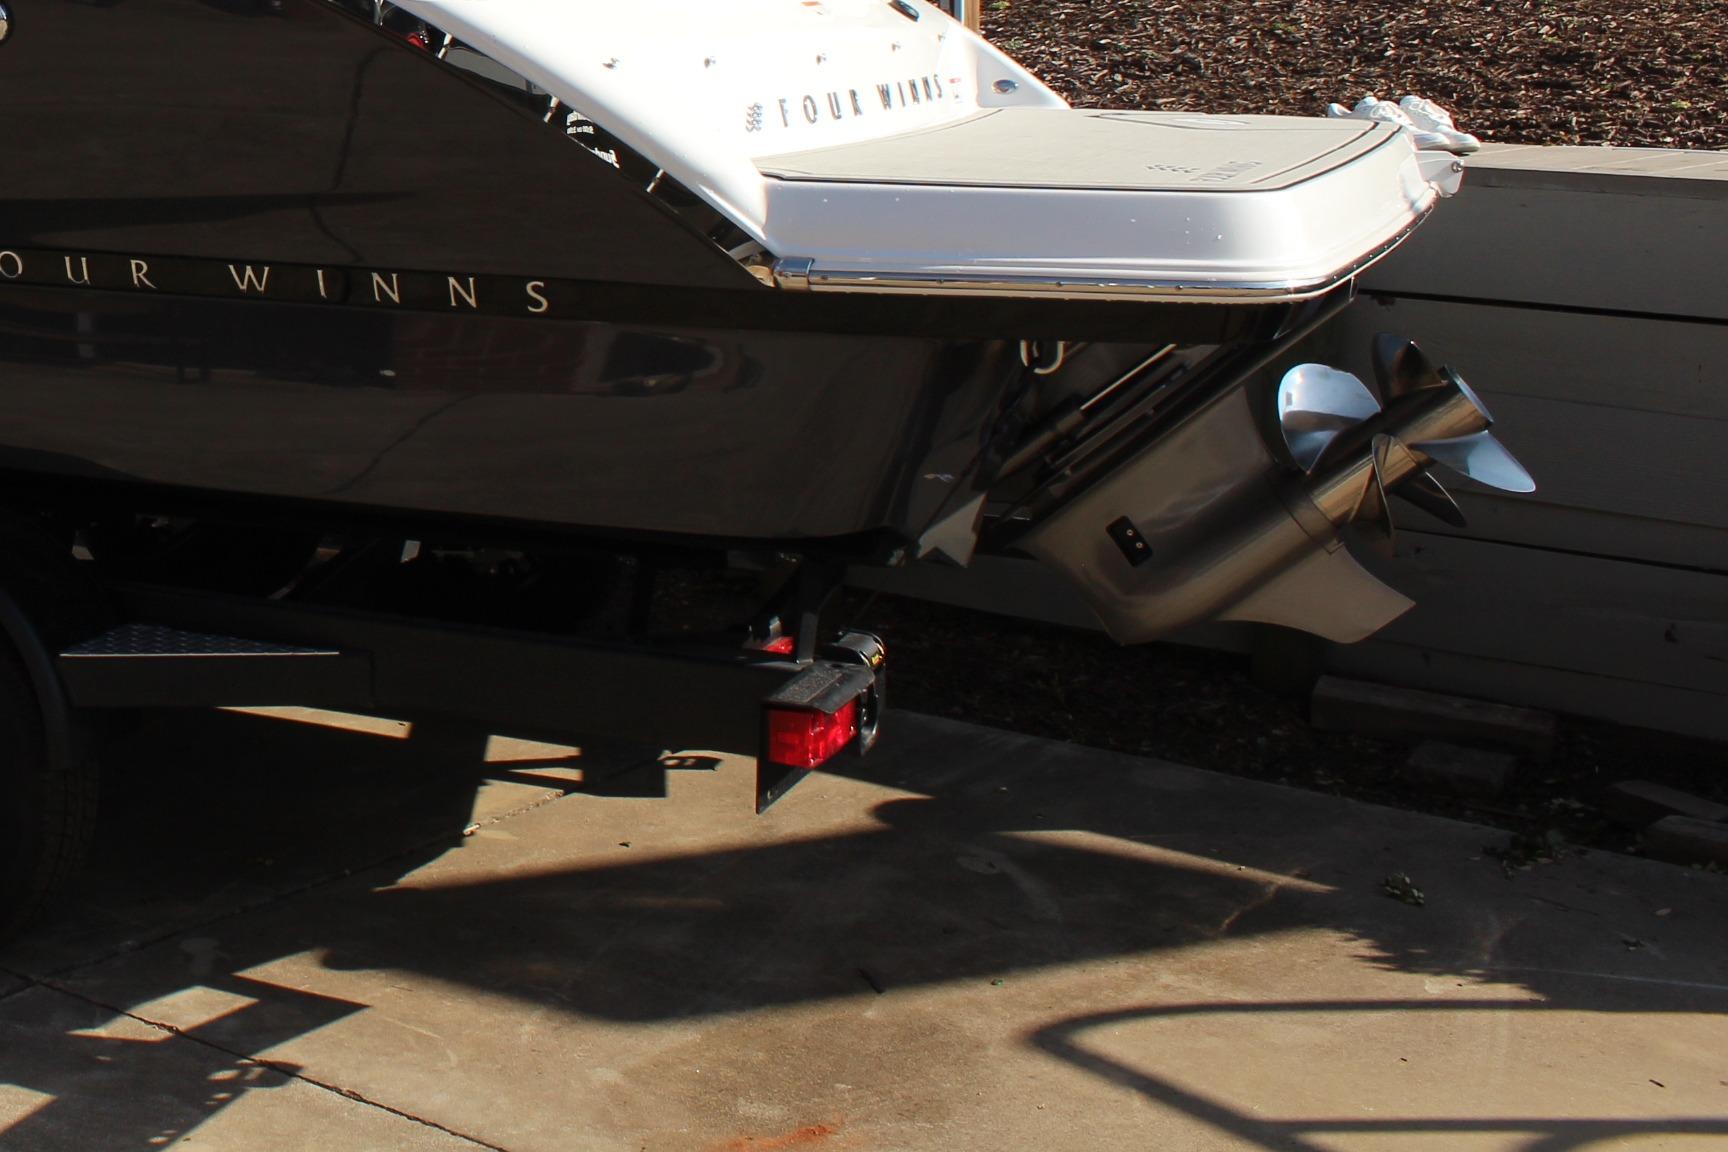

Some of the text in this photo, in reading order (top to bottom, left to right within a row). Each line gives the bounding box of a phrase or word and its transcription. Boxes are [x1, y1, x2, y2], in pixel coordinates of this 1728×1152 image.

[777, 88, 863, 129] FOUR
[875, 73, 943, 111] WINNS
[228, 264, 549, 314] WINNS
